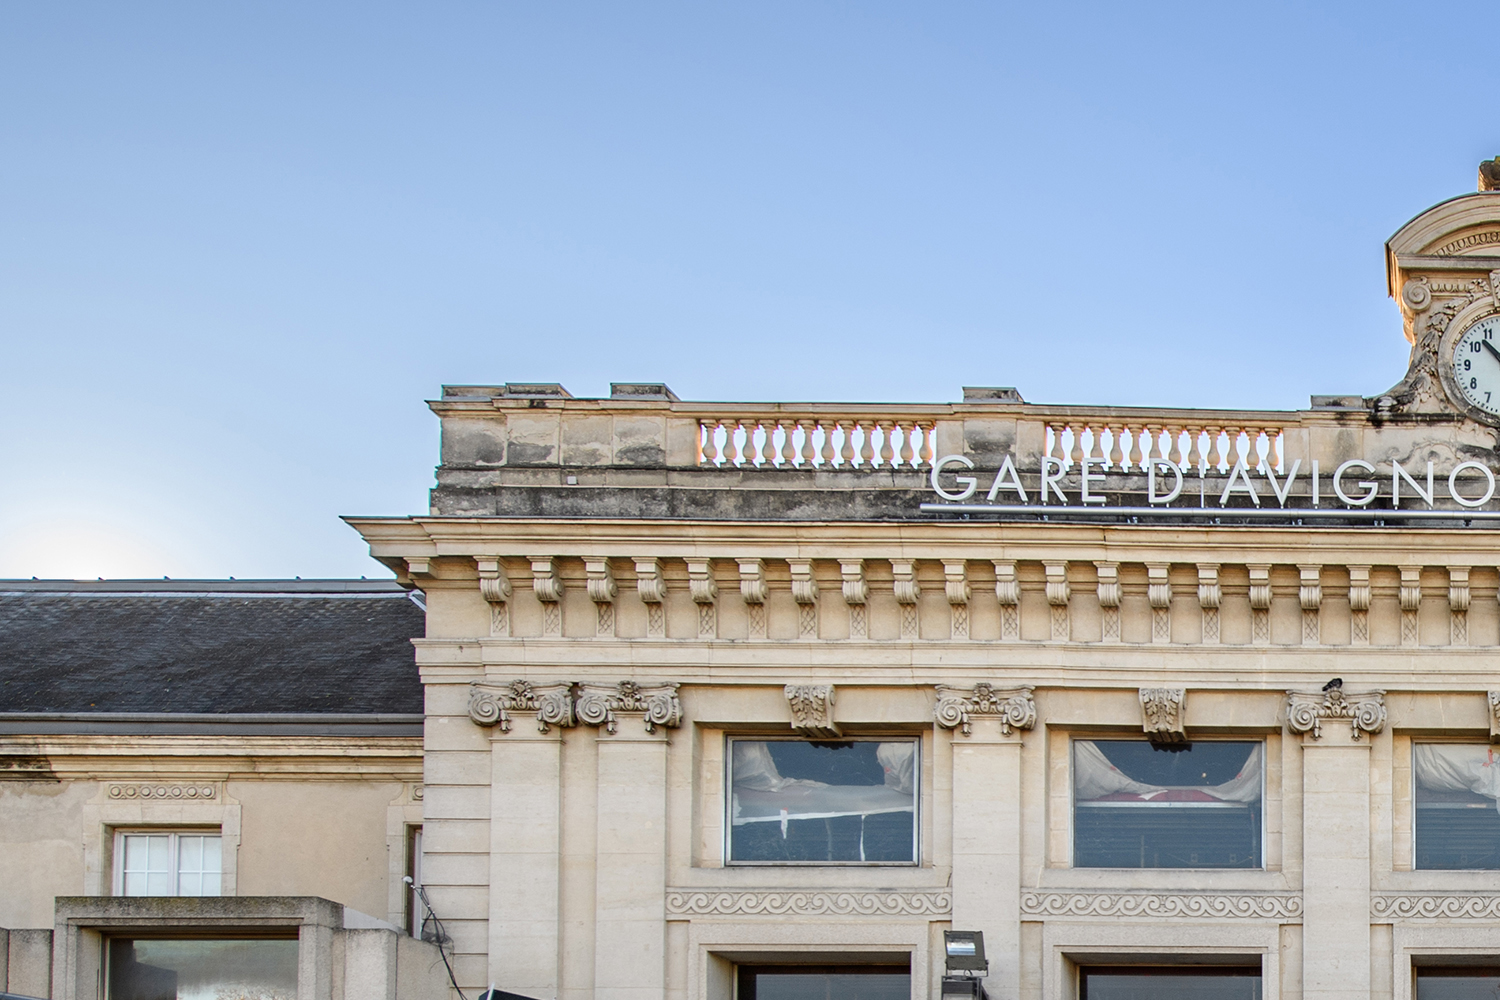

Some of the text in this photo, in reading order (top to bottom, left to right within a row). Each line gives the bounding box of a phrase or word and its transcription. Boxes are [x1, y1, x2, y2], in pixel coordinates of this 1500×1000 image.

[1483, 328, 1492, 339] 11
[1469, 341, 1481, 352] 10
[1464, 359, 1471, 371] 9
[1470, 377, 1477, 389] 8
[1484, 392, 1491, 403] 7
[931, 454, 1107, 504] GARE
